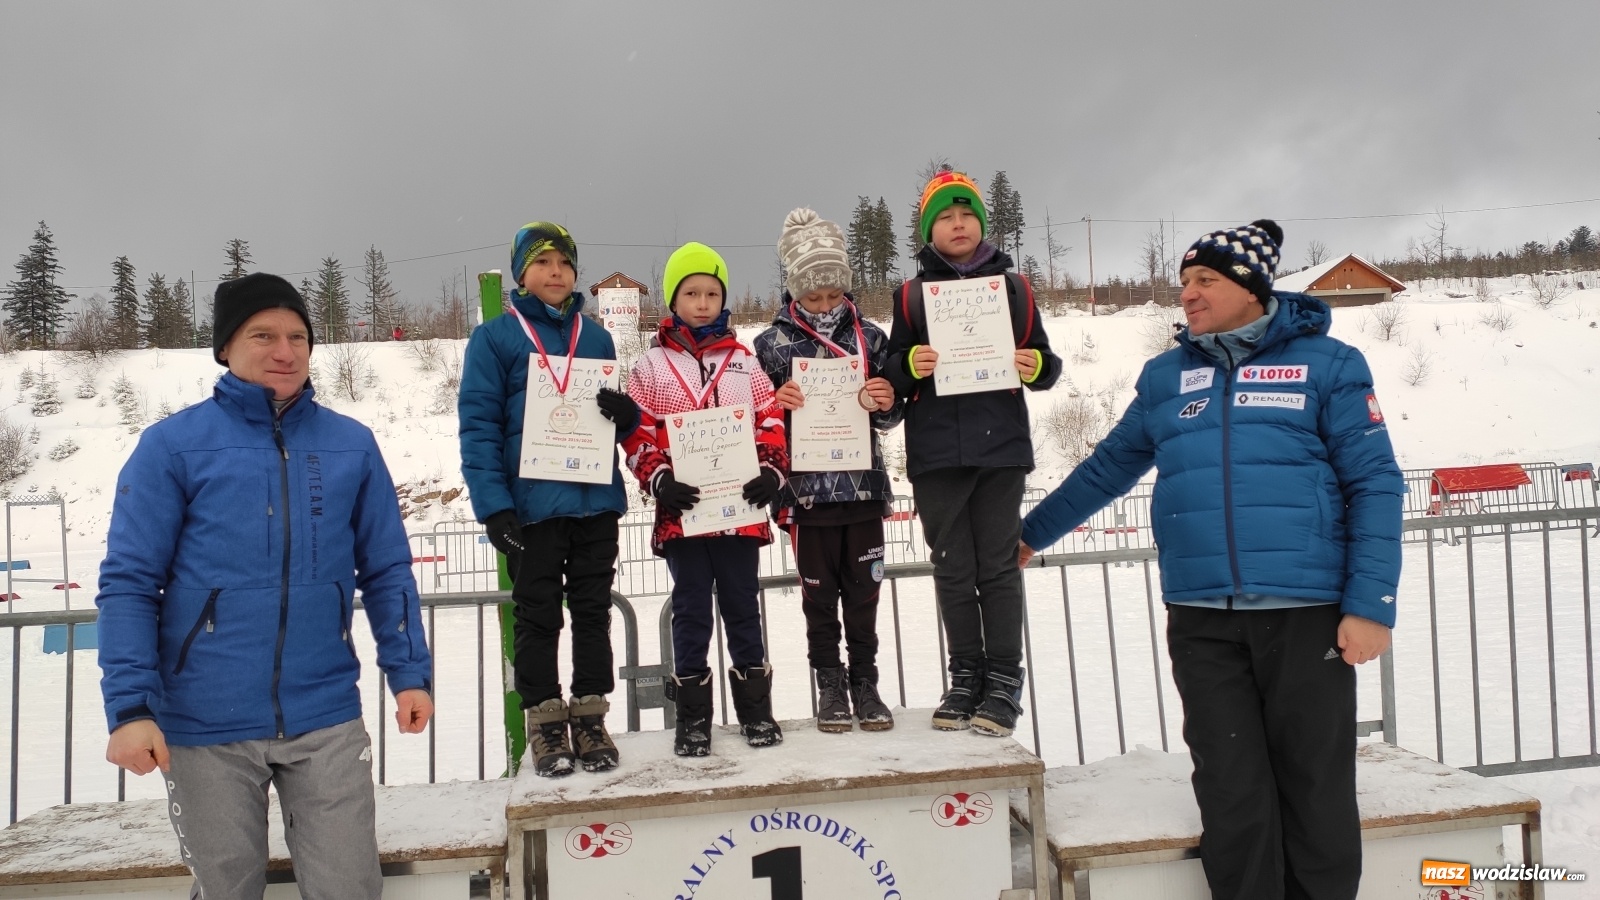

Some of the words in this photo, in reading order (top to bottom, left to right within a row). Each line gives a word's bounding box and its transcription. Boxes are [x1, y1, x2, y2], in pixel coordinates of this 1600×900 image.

[934, 294, 997, 308] DYPLOM
[612, 306, 637, 315] LOTOS
[963, 325, 974, 333] 4
[801, 374, 858, 385] DYPLOM
[1259, 368, 1302, 380] LOTOS
[538, 374, 608, 388] DLOM
[1252, 395, 1302, 404] RENAULT
[825, 404, 836, 412] 3
[678, 424, 742, 442] DYPLOM
[710, 457, 719, 468] 1
[750, 808, 875, 861] OŚRODEK
[752, 846, 803, 900] 1
